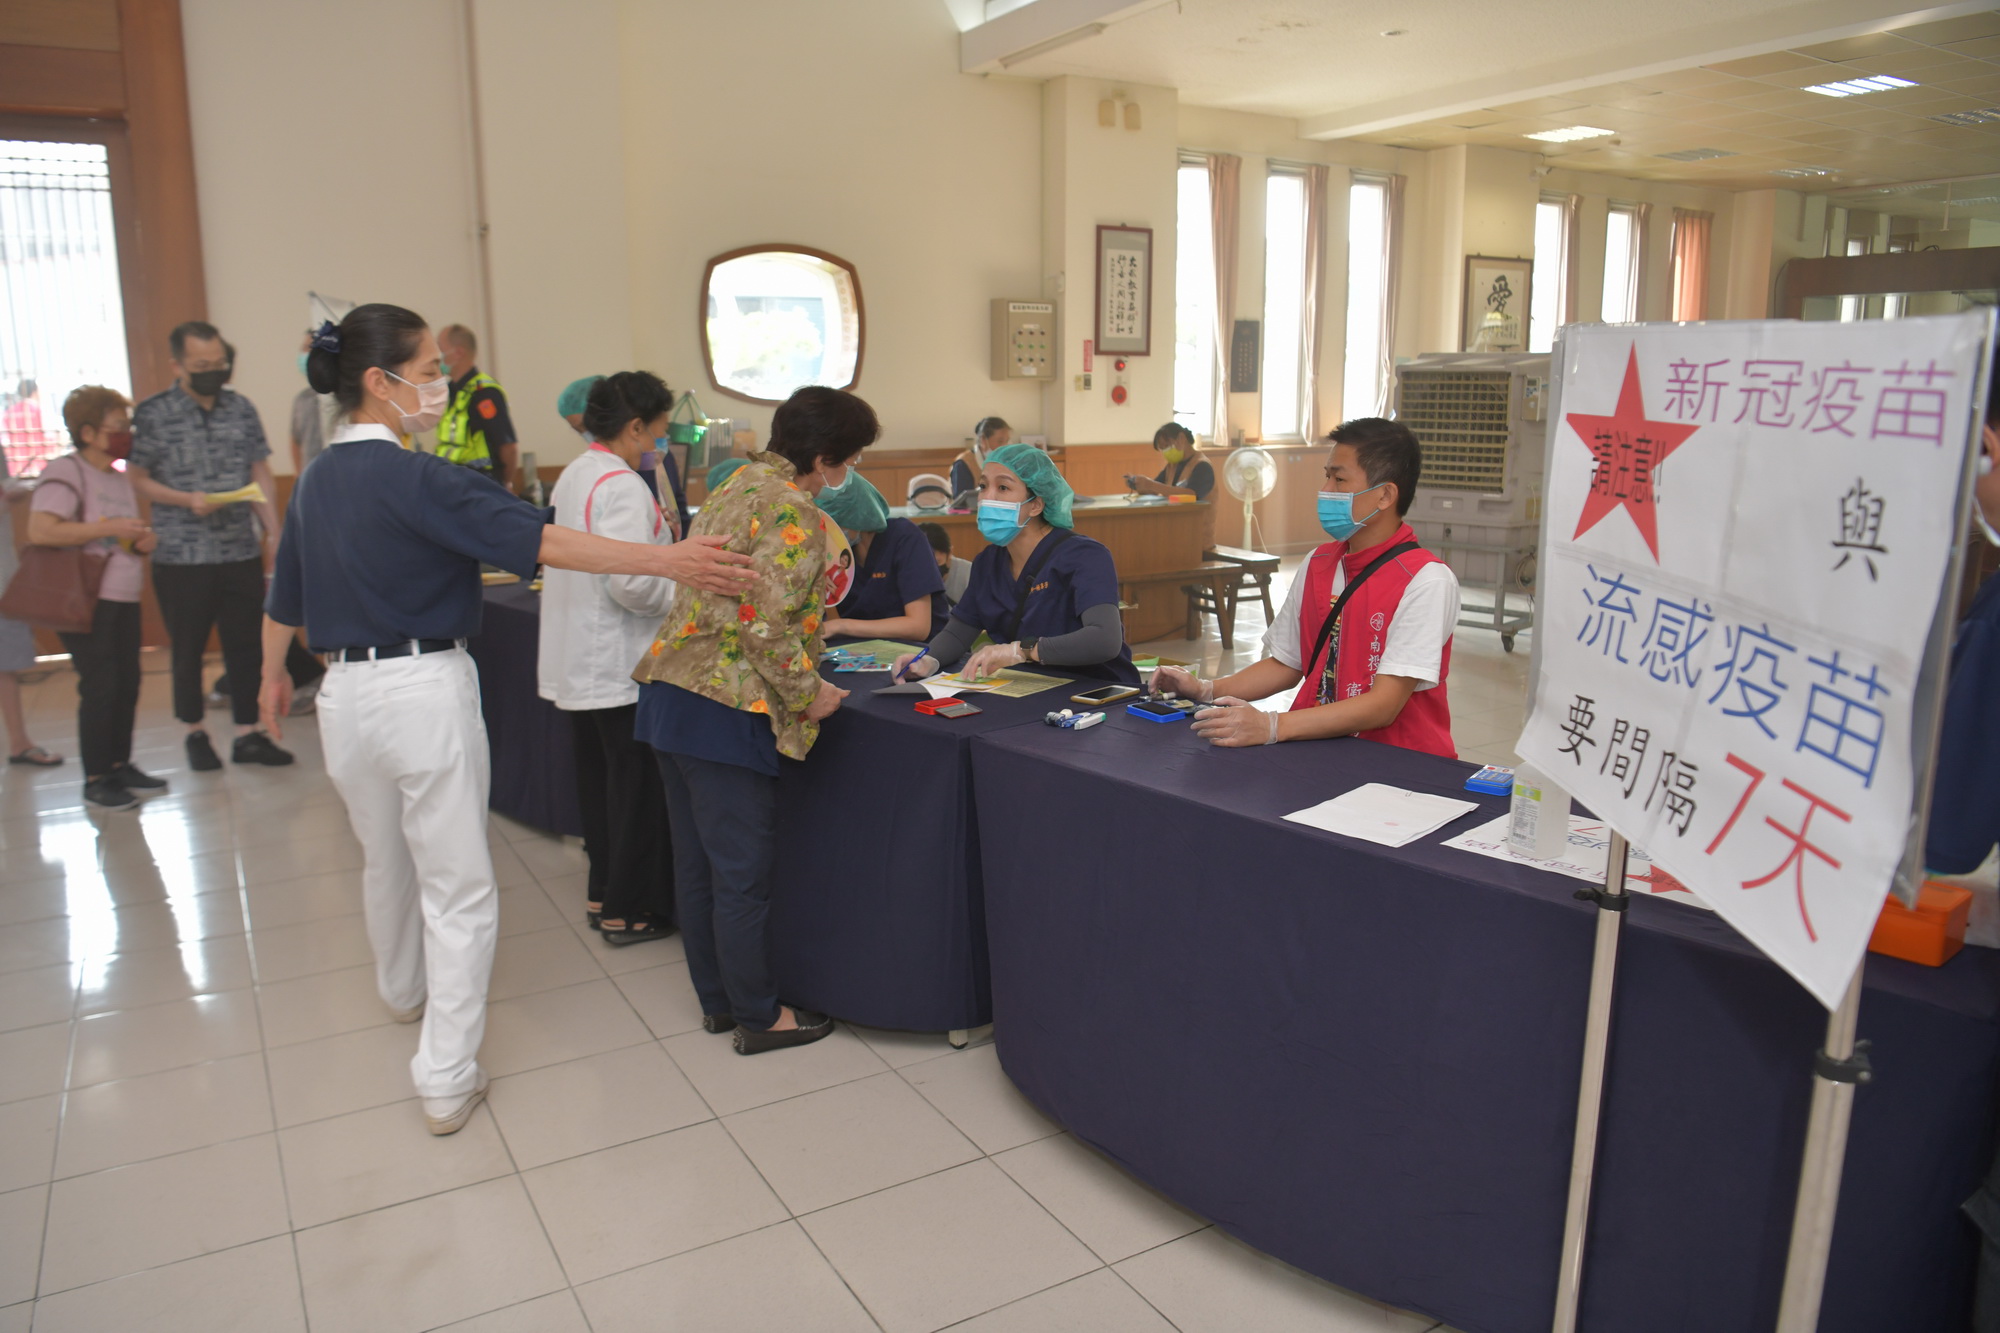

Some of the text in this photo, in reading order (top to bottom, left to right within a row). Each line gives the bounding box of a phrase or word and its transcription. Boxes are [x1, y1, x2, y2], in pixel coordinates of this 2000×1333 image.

[1664, 356, 1957, 448] 新冠疫苗
[1830, 477, 1889, 582] 與
[1575, 562, 1892, 790] 流感疫苗
